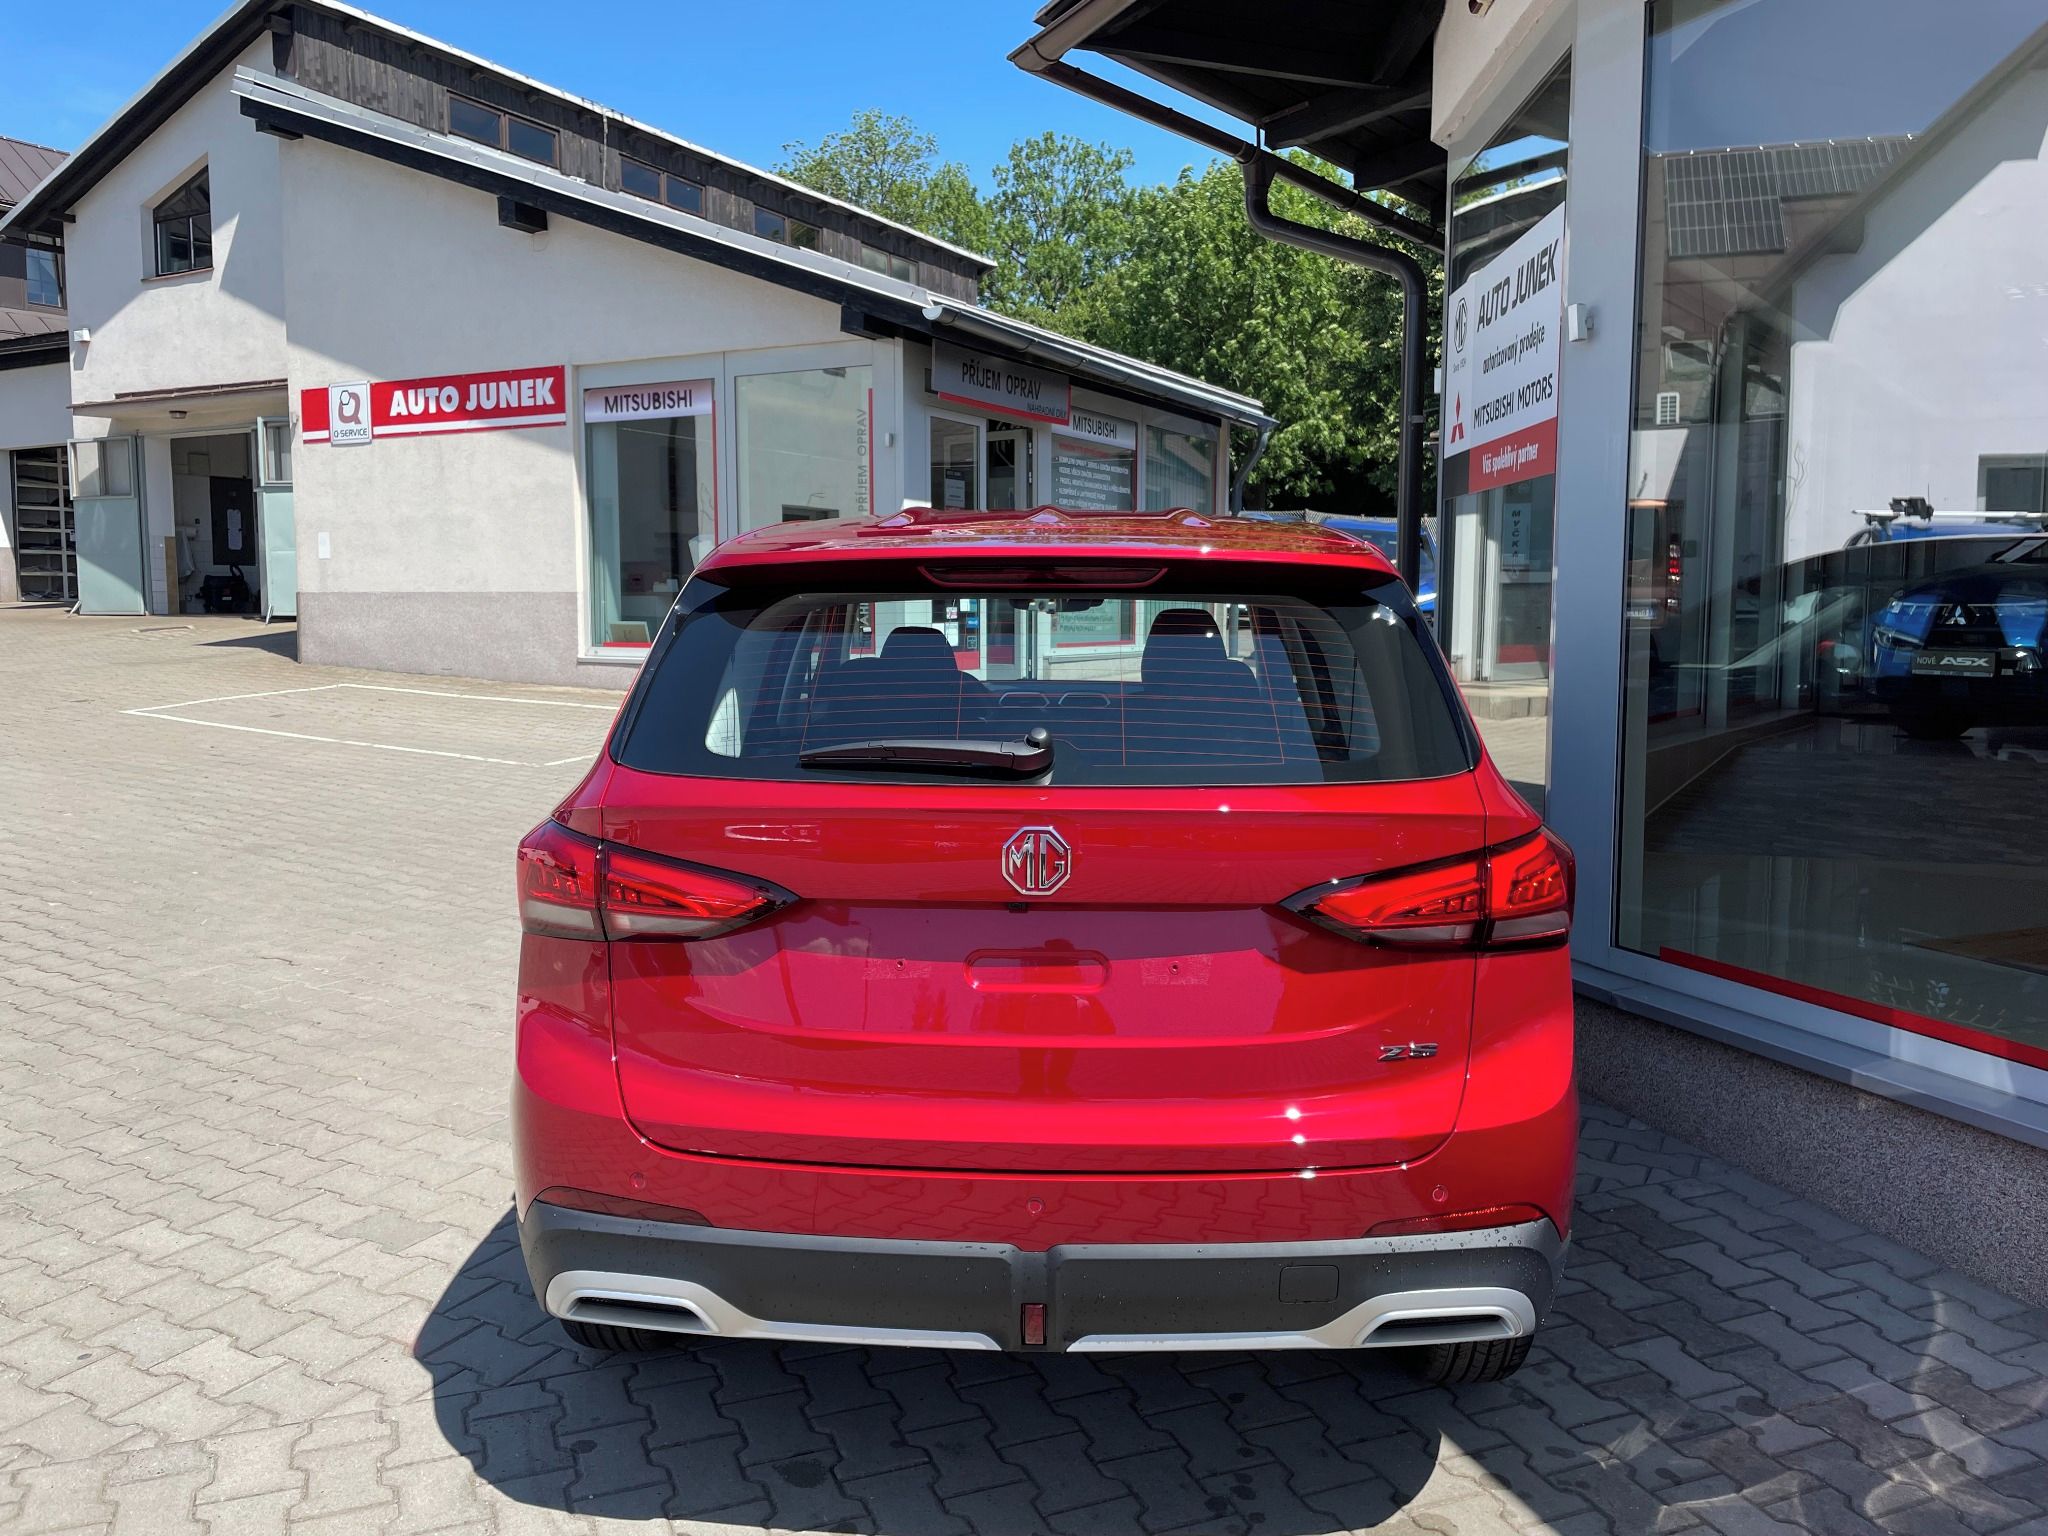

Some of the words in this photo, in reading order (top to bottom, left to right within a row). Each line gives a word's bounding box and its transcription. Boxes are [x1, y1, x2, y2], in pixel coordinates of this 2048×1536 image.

[1477, 276, 1511, 333] AUTO
[1512, 238, 1559, 309] JUNEK
[1454, 299, 1468, 353] MG
[1483, 334, 1518, 374] autorizovaný
[1519, 321, 1545, 363] prodejce
[390, 386, 459, 417] AUTO
[465, 377, 555, 411] JUNEK
[604, 389, 692, 414] MITSUBISHI
[962, 358, 1000, 391] PŘÍJEM
[1006, 375, 1041, 400] OPRAV
[1473, 391, 1514, 430] MITSUBISHI
[1518, 373, 1553, 411] MOTORS
[857, 408, 869, 457] OPRAV
[1072, 414, 1118, 440] MITSUBISHI
[1517, 443, 1539, 471] partner
[857, 465, 869, 513] PŘÍJEM
[1916, 655, 1936, 665] NOVÉ
[1939, 656, 1989, 667] ASX
[1006, 830, 1067, 891] MG
